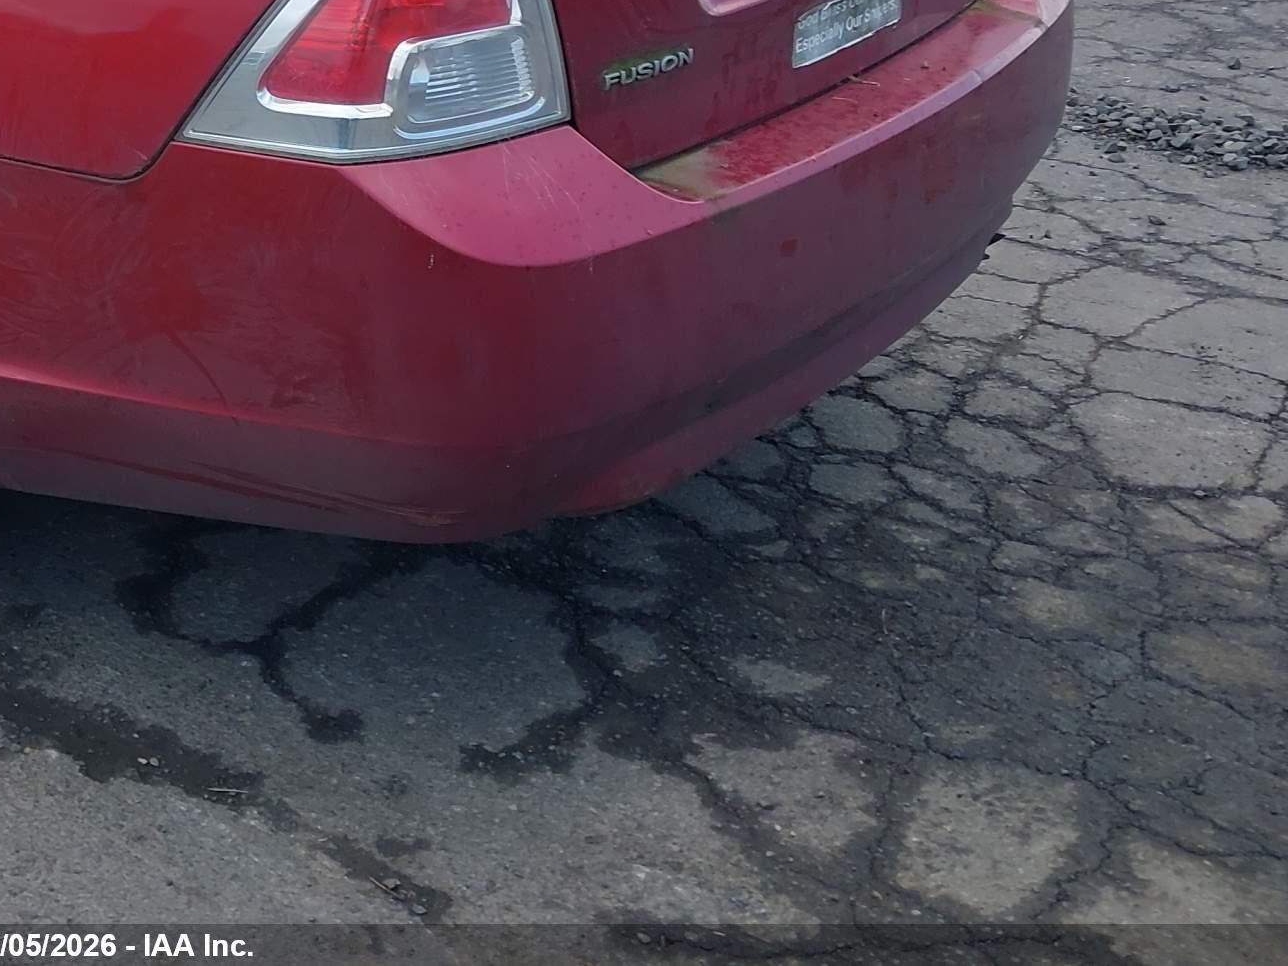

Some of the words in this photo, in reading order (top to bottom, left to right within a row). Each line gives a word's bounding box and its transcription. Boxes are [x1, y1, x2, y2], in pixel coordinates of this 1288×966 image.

[795, 21, 845, 53] Especially
[845, 13, 863, 31] Our
[603, 47, 695, 91] FUSION
